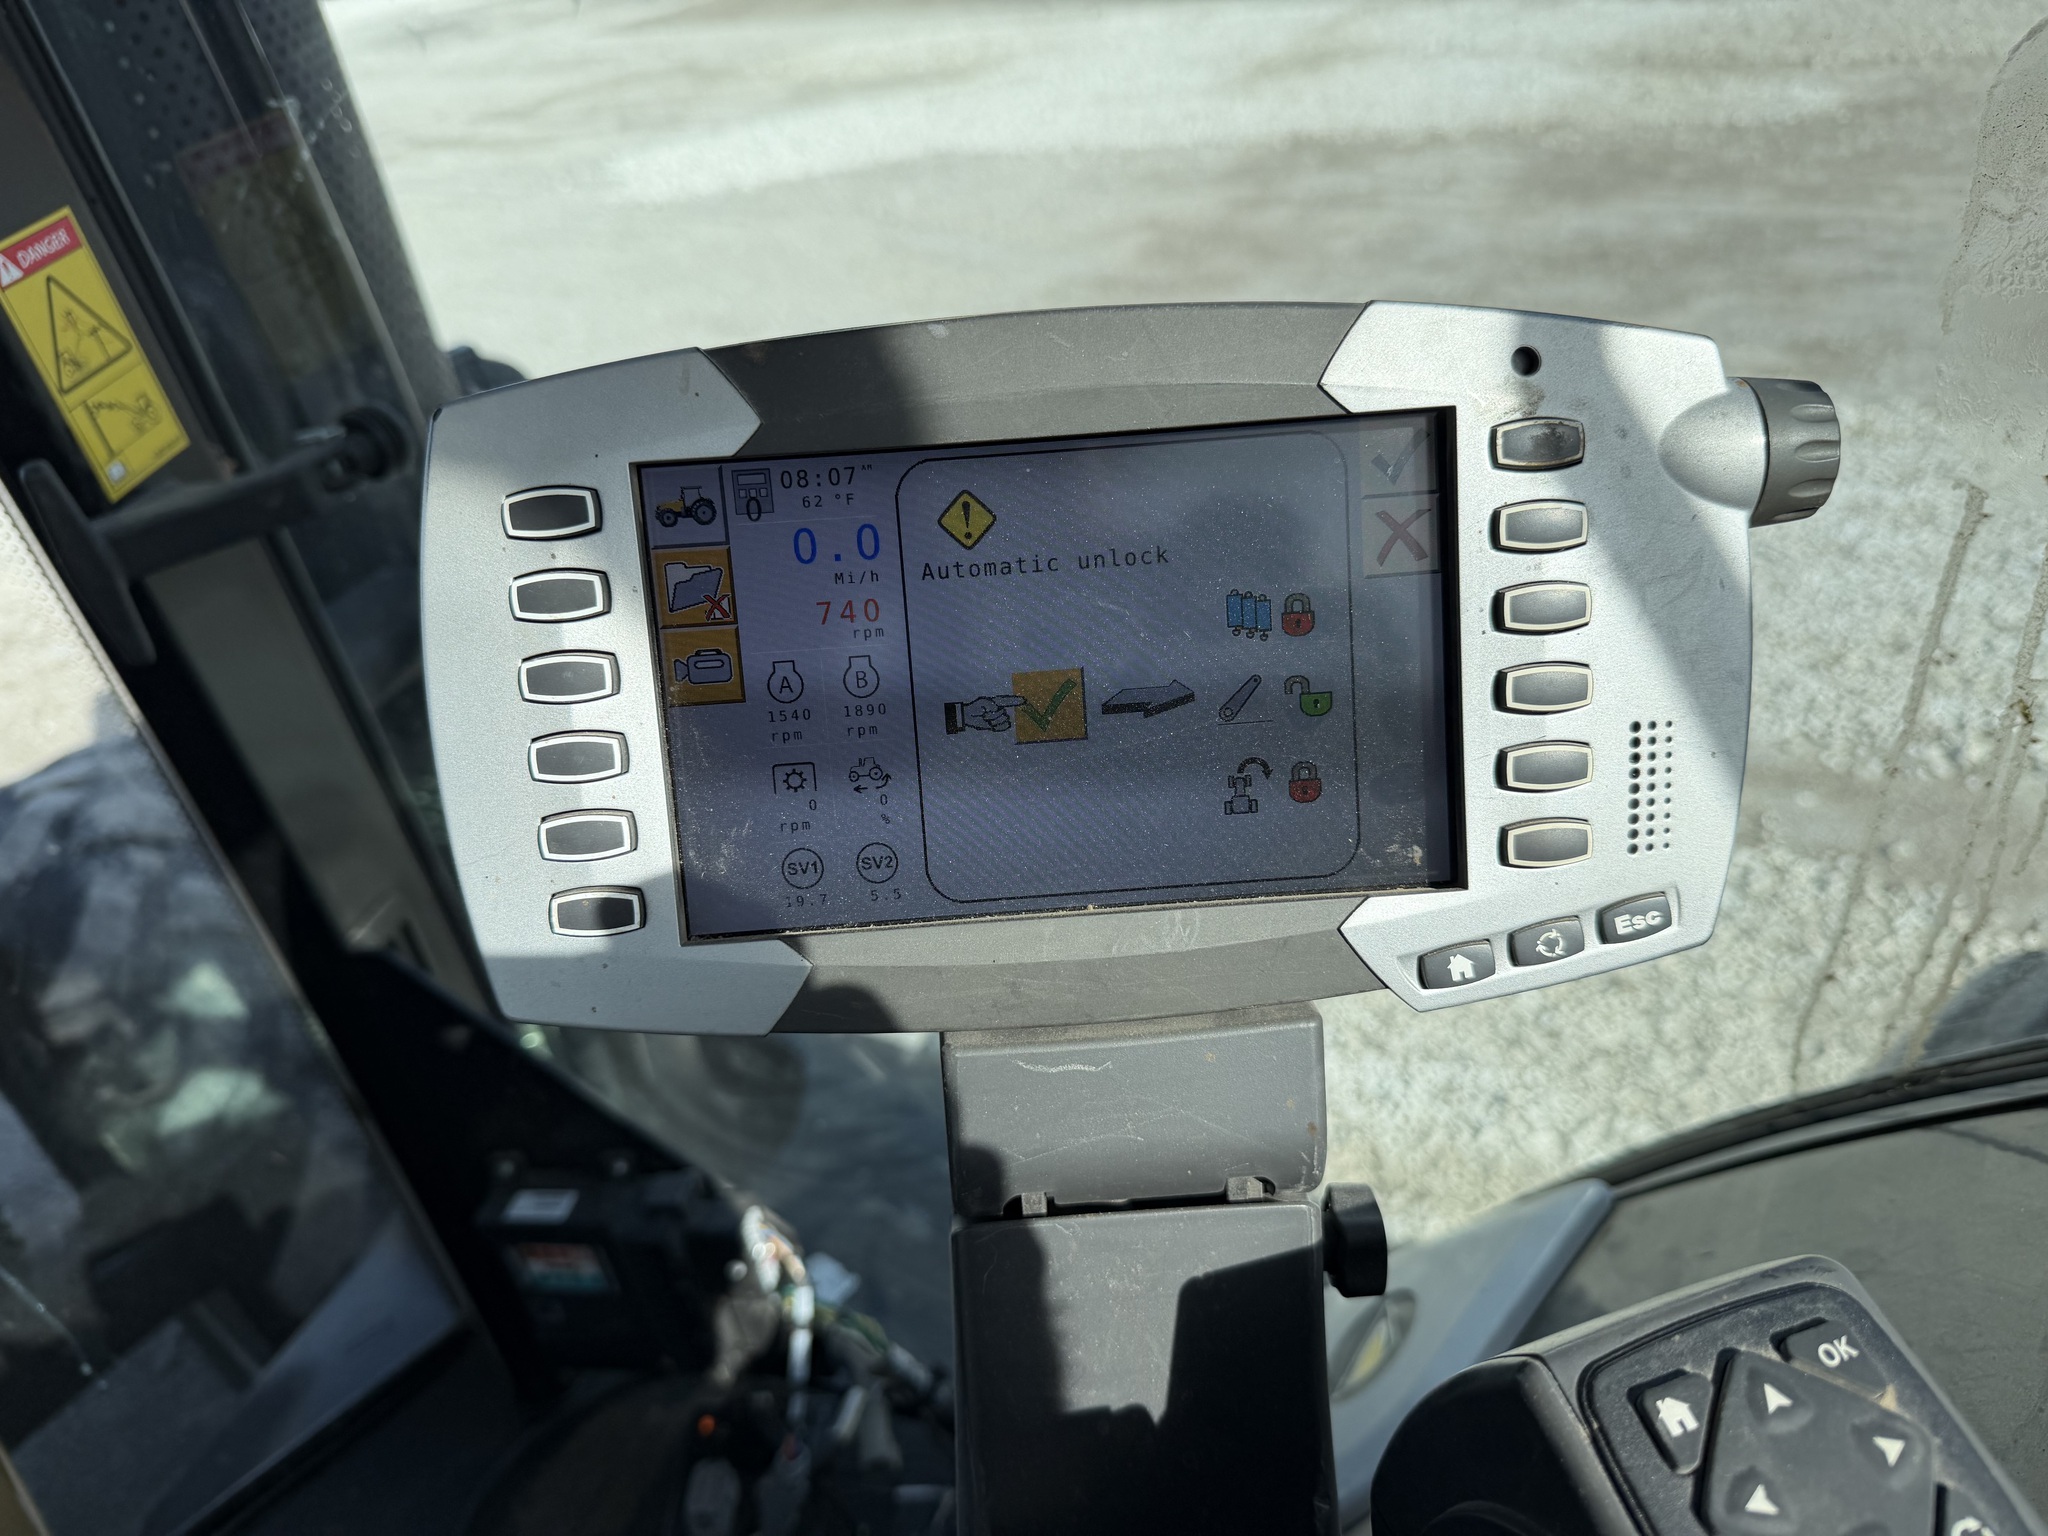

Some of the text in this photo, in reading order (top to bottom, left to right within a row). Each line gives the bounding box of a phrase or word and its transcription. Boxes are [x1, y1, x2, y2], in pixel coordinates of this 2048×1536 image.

[16, 227, 71, 269] DANGER
[780, 466, 856, 489] 08:07
[802, 493, 855, 508] 62 °F
[793, 523, 880, 564] 0.0
[921, 545, 1169, 581] Automatic unlock
[834, 570, 879, 585] Mi/h
[816, 598, 880, 625] 740
[853, 627, 885, 640] rpm
[779, 674, 794, 694] A
[854, 670, 868, 690] B
[768, 708, 811, 722] 1540
[844, 703, 887, 717] 1890
[771, 730, 803, 743] rpm
[847, 725, 878, 738] rpm
[809, 799, 818, 811] 0
[879, 794, 888, 806] 0
[780, 820, 811, 833] rpm
[787, 862, 819, 875] SV1
[861, 856, 894, 870] SV2
[870, 889, 902, 902] 5.5
[1614, 910, 1663, 935] Esc
[1817, 1334, 1860, 1368] OK
